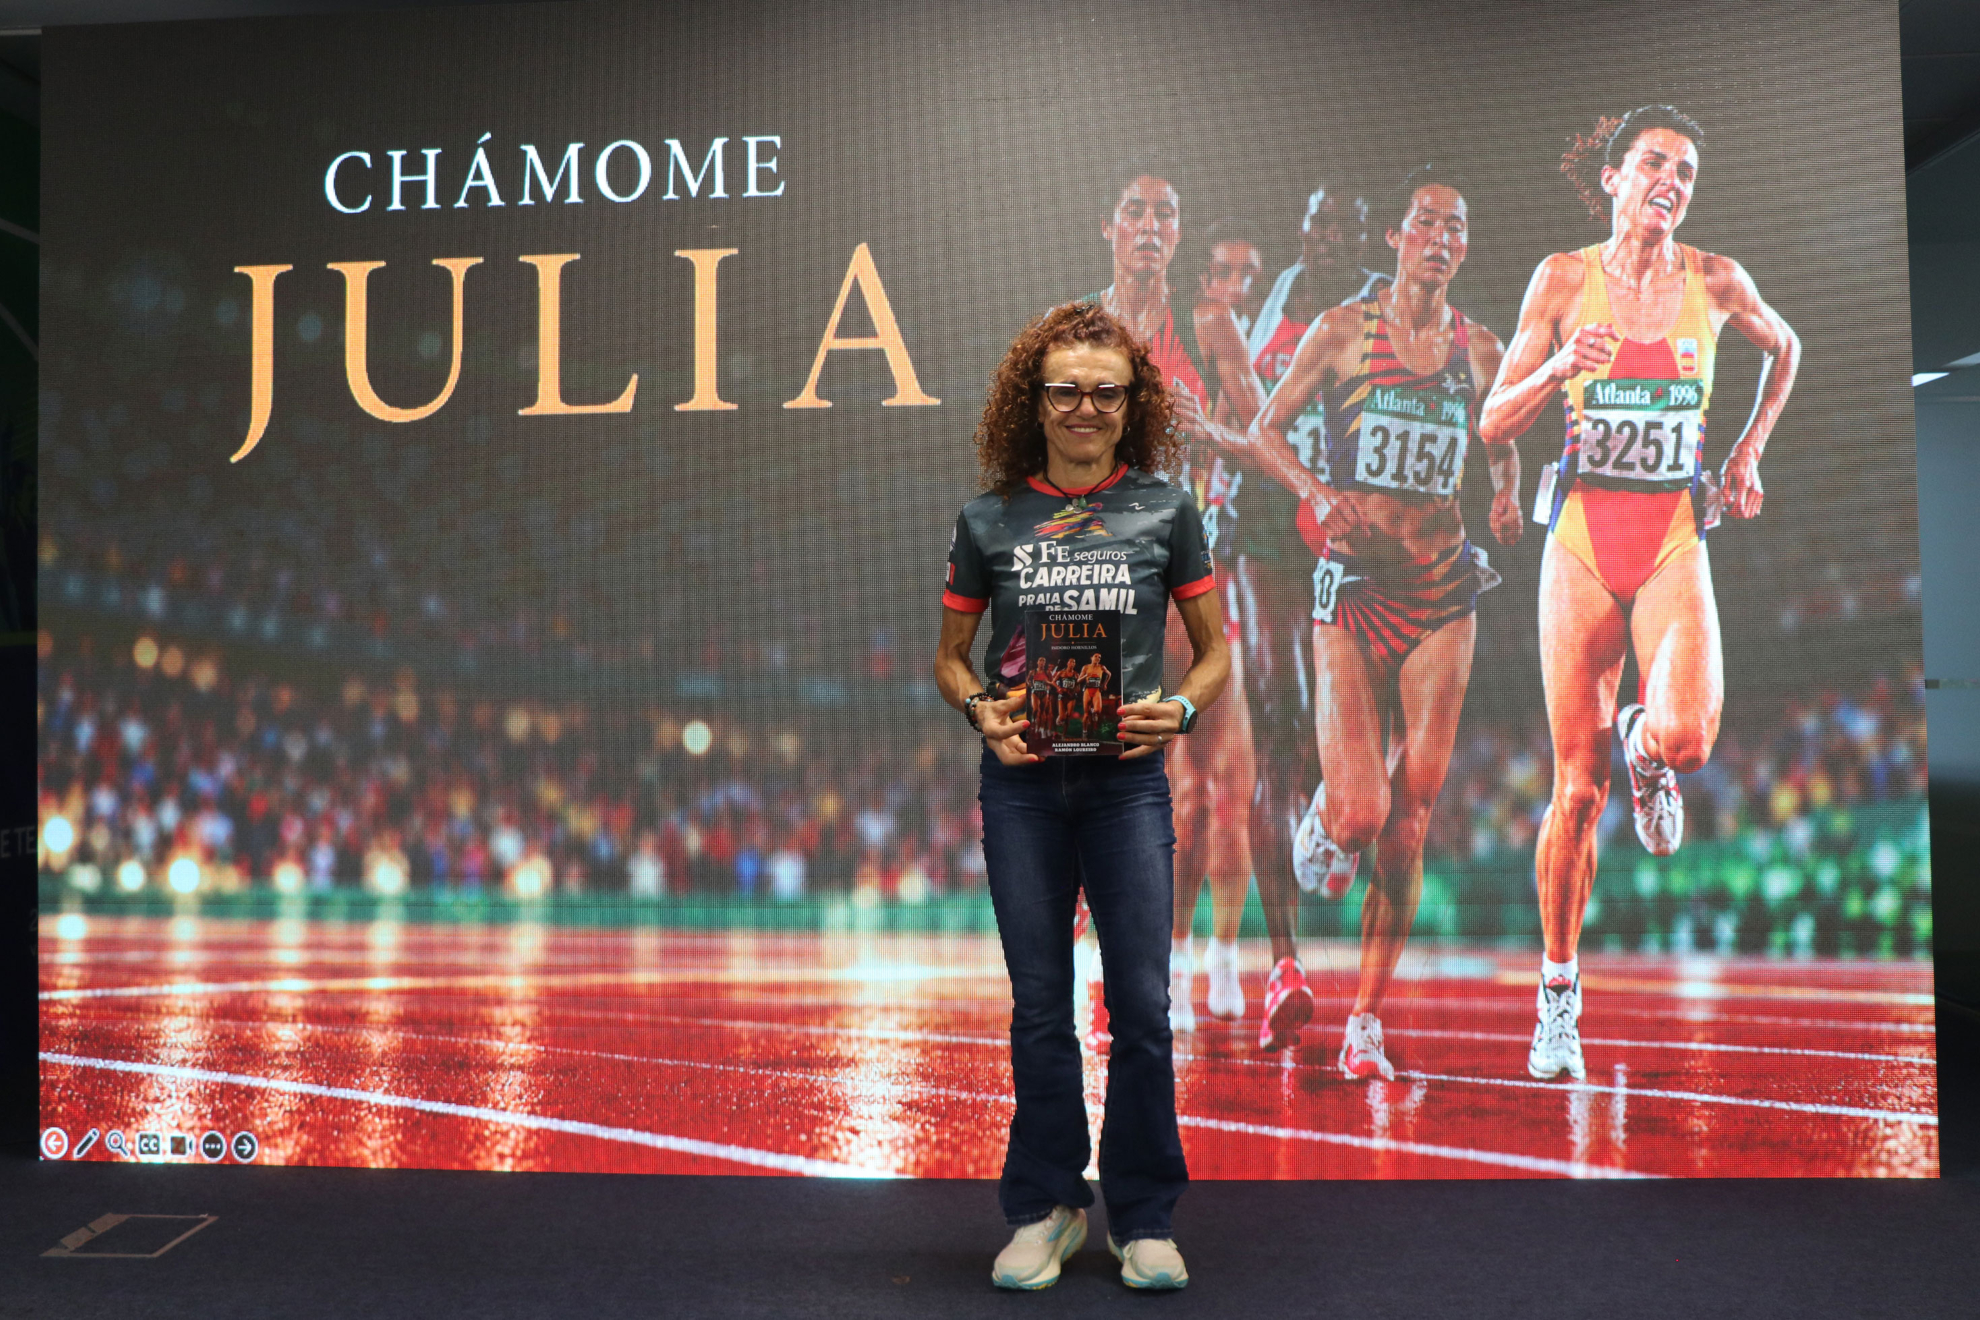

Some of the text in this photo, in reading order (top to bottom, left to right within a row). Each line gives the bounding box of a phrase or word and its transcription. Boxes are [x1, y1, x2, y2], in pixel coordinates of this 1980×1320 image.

[323, 132, 787, 214] CHÁMOME
[229, 241, 942, 464] JULIA
[1371, 387, 1425, 416] Atlanta
[1592, 382, 1698, 406] Atlanta 1996
[1365, 425, 1458, 489] 3154
[1587, 418, 1685, 473] 3251
[1073, 550, 1127, 564] seguros
[1019, 563, 1132, 589] CARREIRA
[1018, 587, 1138, 615] PRAIA SAMIL
[1049, 613, 1094, 621] CHÁMOME
[1041, 622, 1108, 641] JULIA
